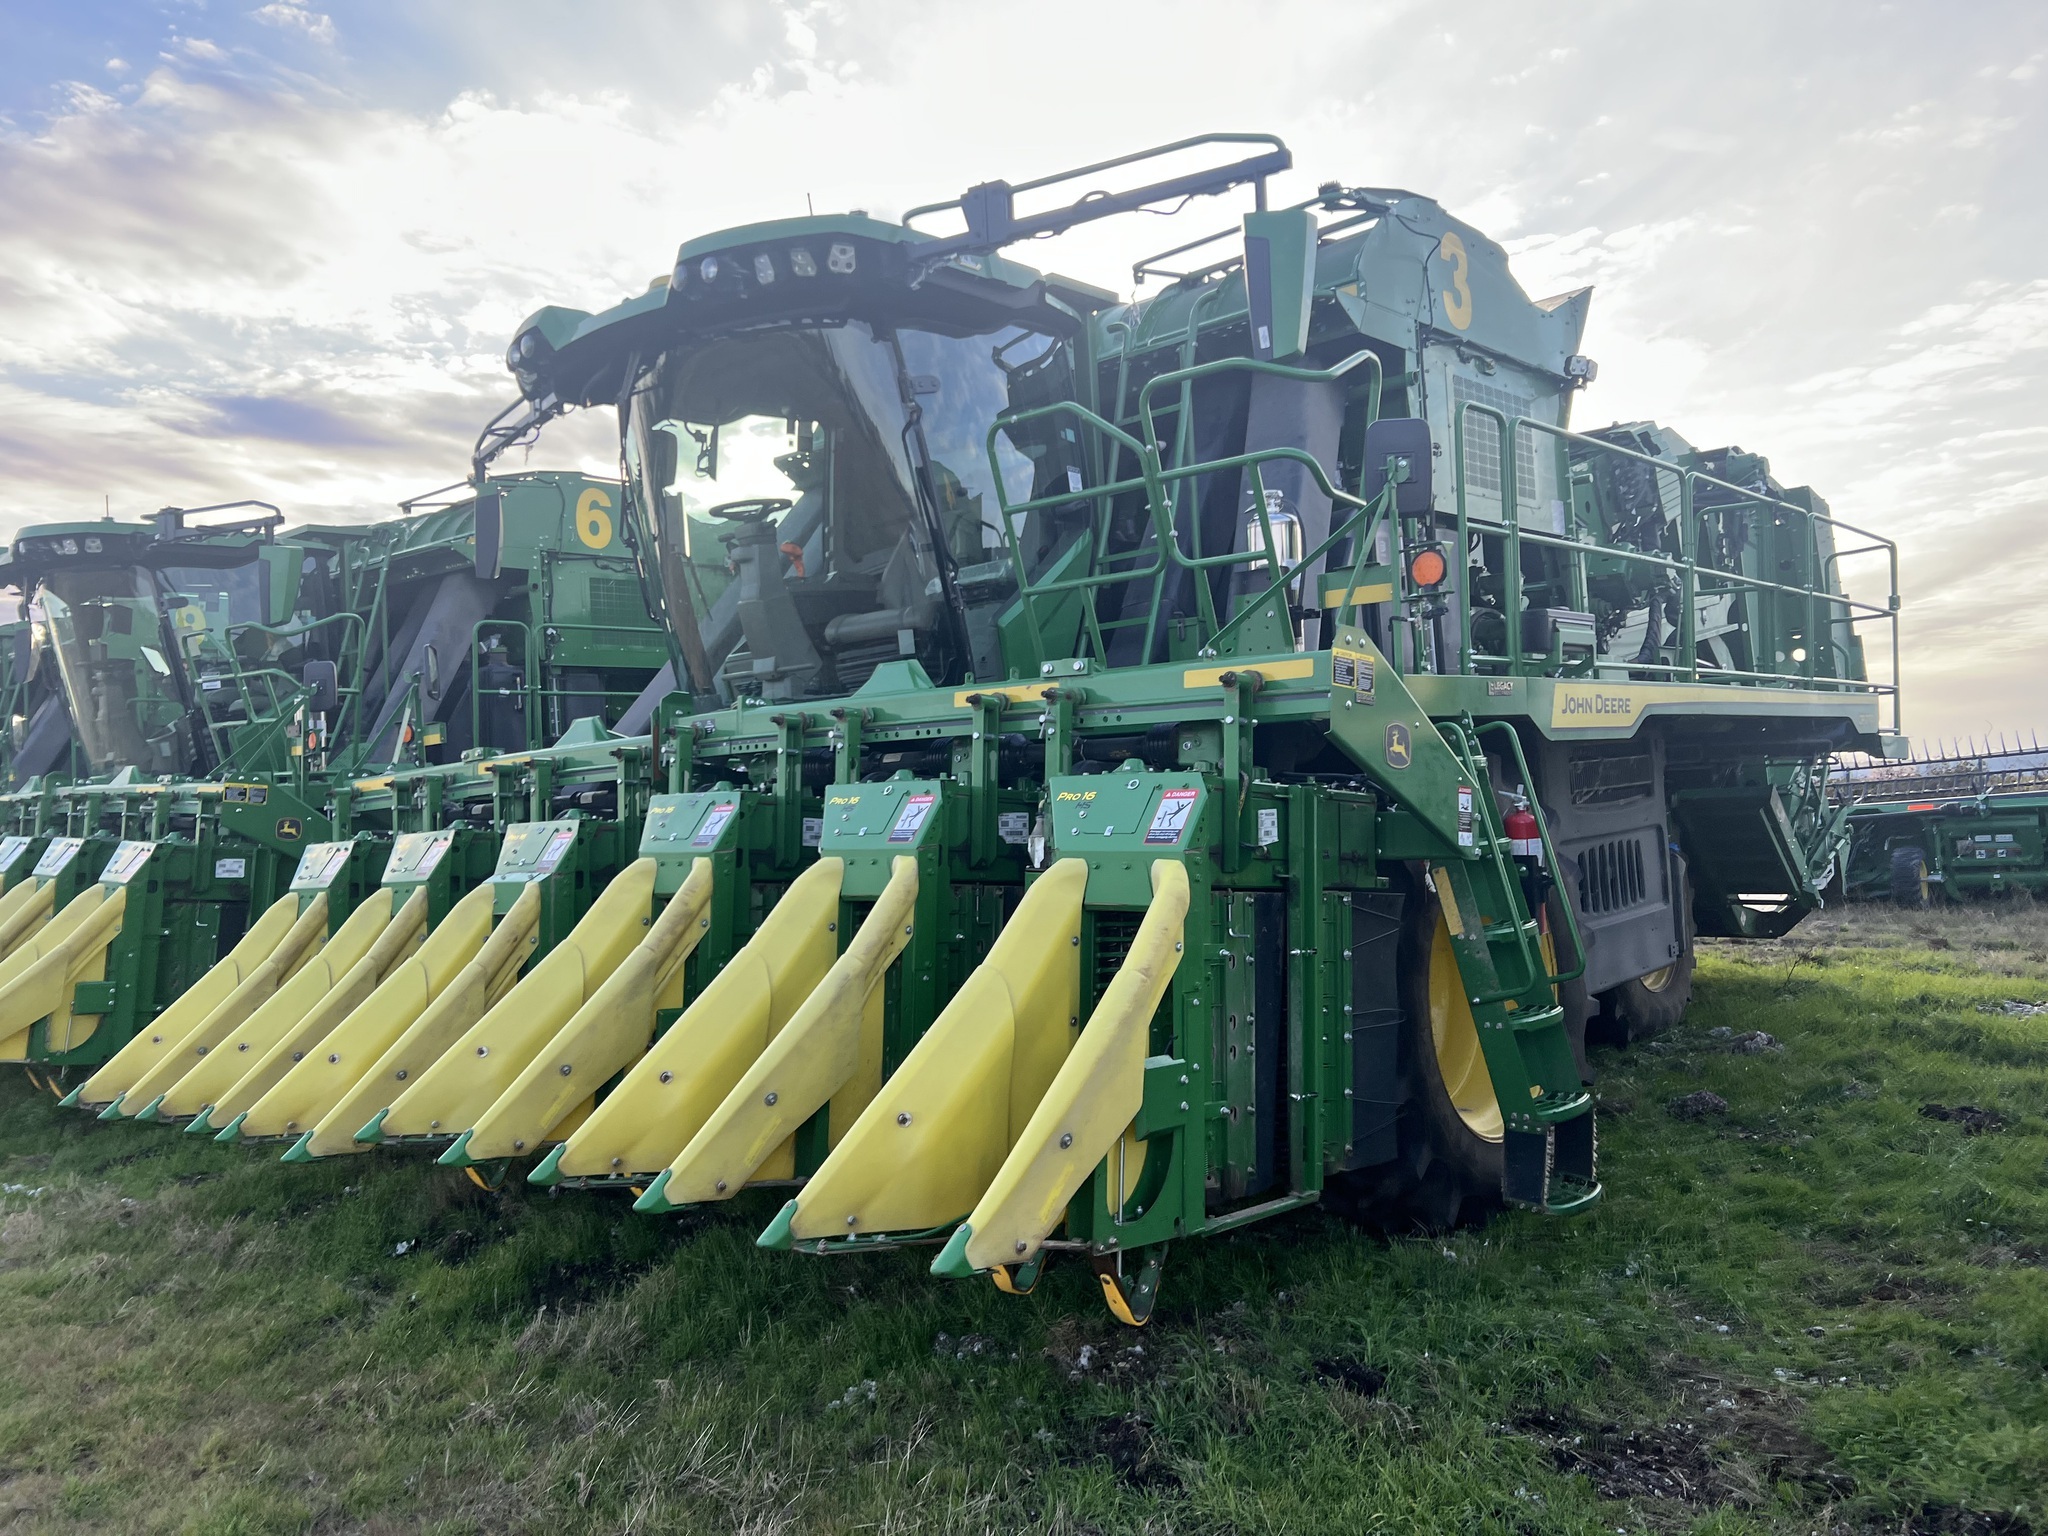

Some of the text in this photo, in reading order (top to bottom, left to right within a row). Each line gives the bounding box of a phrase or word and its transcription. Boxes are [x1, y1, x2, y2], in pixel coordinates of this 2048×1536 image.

[1440, 231, 1472, 331] 3
[575, 487, 612, 549] 6
[1562, 693, 1631, 714] JOHN DEERE
[848, 796, 861, 805] 16
[1082, 791, 1098, 801] 16
